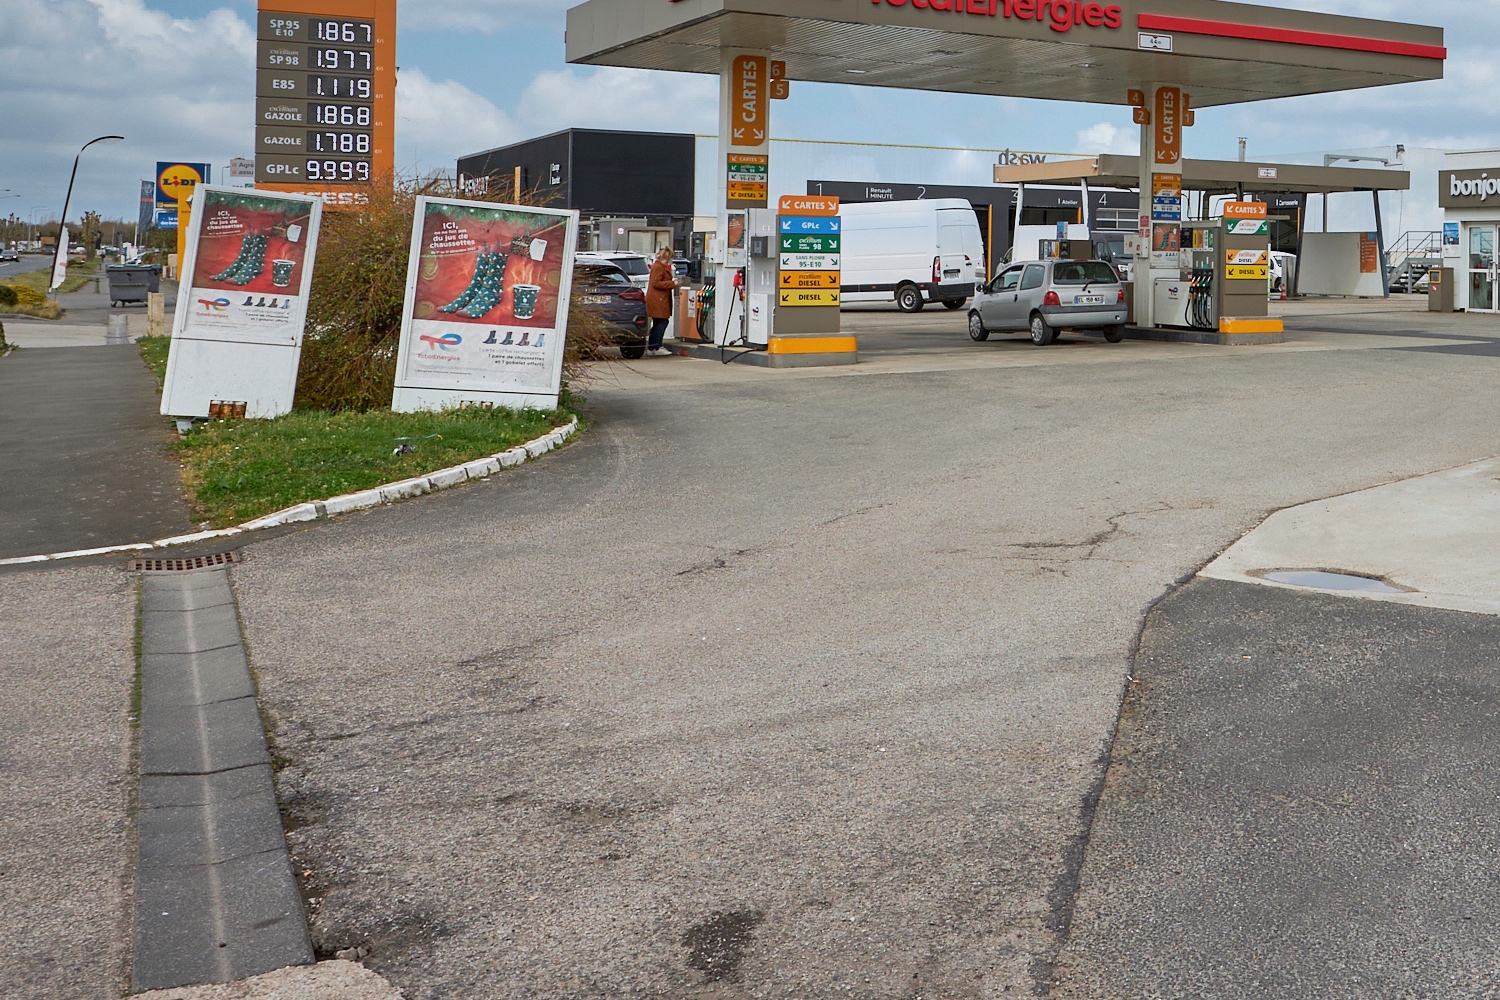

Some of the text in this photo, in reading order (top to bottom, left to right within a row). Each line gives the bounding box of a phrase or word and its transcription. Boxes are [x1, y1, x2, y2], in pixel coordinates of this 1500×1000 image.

[318, 22, 371, 42] 1.867
[317, 49, 371, 70] 1.977
[772, 65, 780, 76] 6
[272, 79, 295, 90] E85
[316, 77, 371, 98] 1.119
[776, 84, 784, 96] 5
[742, 60, 757, 122] CARTES
[1132, 93, 1139, 103] 4
[264, 112, 302, 121] GAZOLE
[316, 105, 370, 126] 1.868
[1138, 111, 1145, 121] 2
[1163, 91, 1174, 144] CARTES
[1185, 113, 1190, 123] 1
[264, 136, 302, 146] GAZOLE
[316, 133, 370, 153] 1.788
[266, 164, 299, 174] GPLc
[816, 183, 822, 197] 1
[917, 187, 926, 200] 2
[1099, 193, 1107, 205] 4
[794, 201, 825, 210] CARTES
[1235, 206, 1257, 214] CARTES
[430, 239, 475, 248] chaussettes
[418, 353, 460, 362] TotalEnergies
